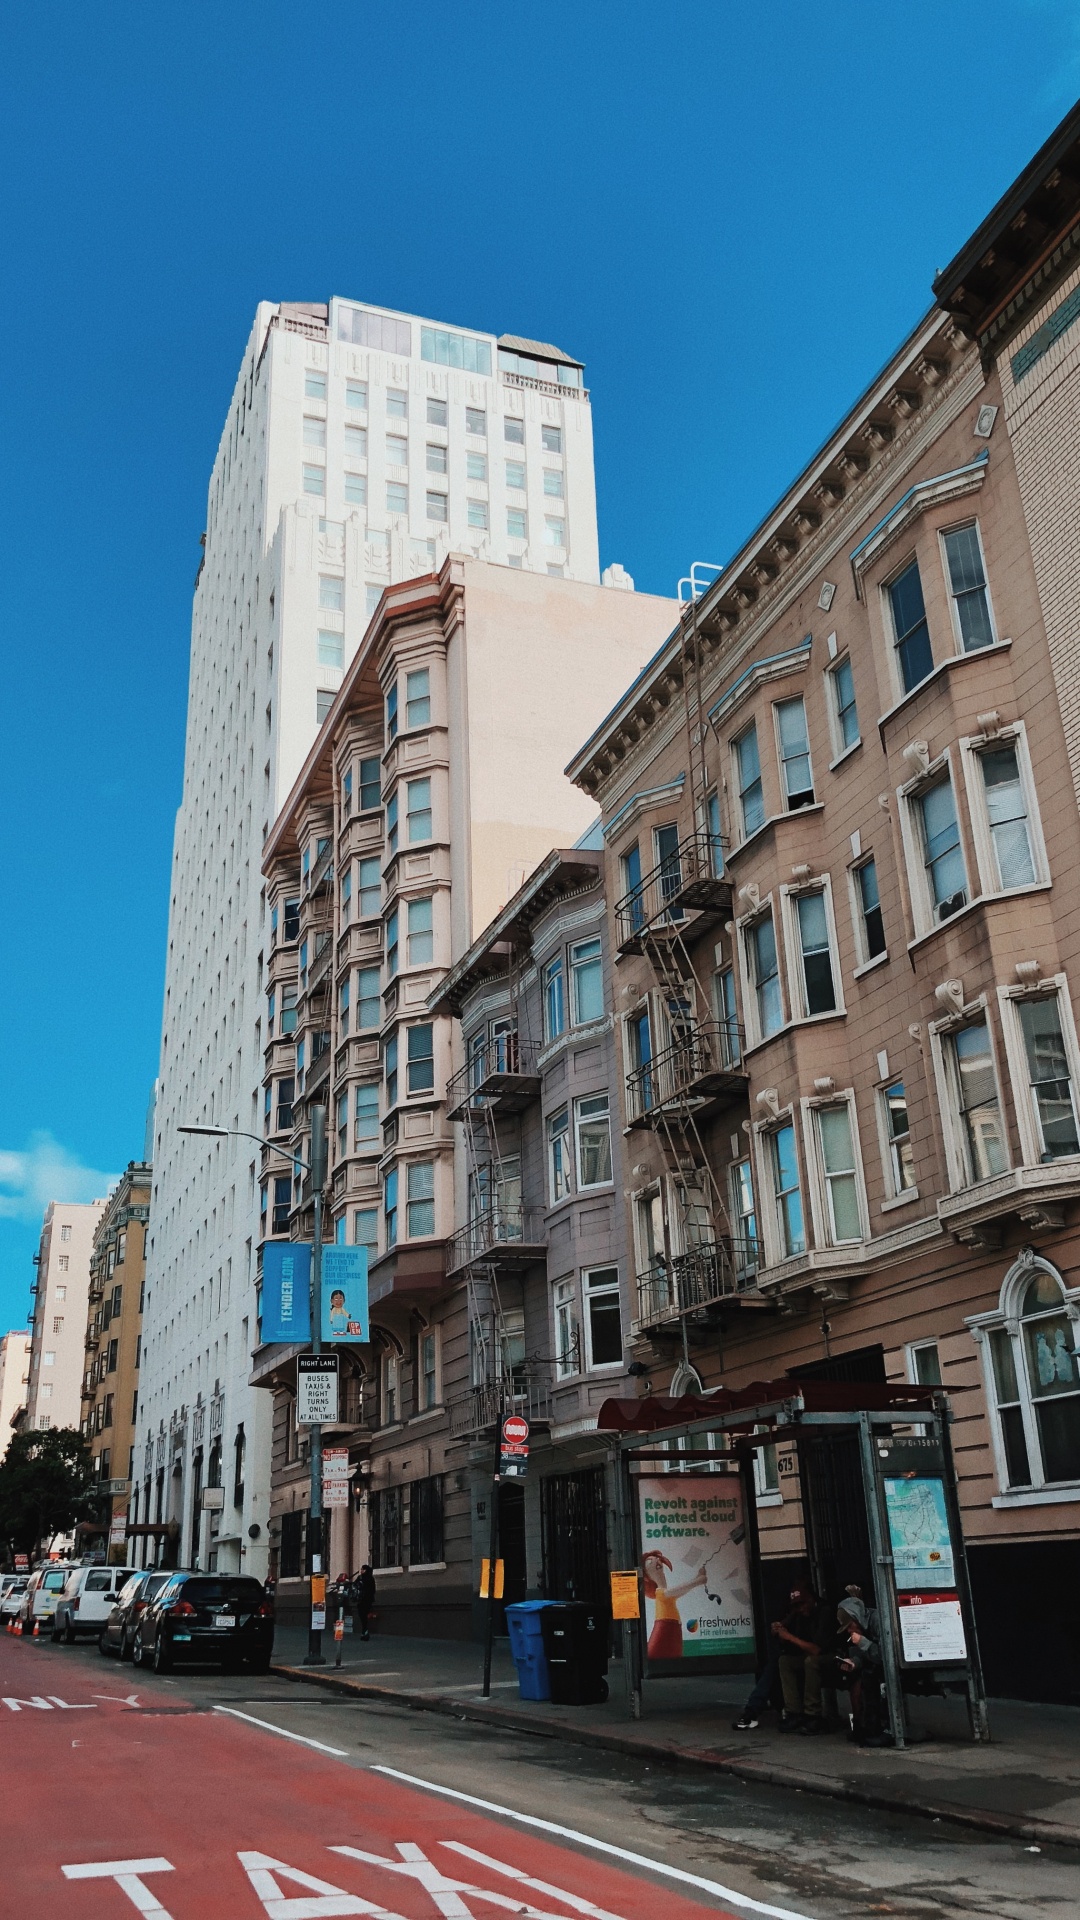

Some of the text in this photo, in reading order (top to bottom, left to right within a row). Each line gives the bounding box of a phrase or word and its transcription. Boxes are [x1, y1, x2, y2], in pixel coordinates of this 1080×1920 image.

[281, 1257, 294, 1322] TENDERLOIN
[778, 1457, 793, 1473] 675
[644, 1495, 738, 1512] Revolt against
[645, 1510, 736, 1524] bloated cloud
[646, 1525, 710, 1538] software.
[910, 1595, 923, 1605] info
[699, 1615, 751, 1628] freshworks
[0, 1695, 142, 1711] NLY
